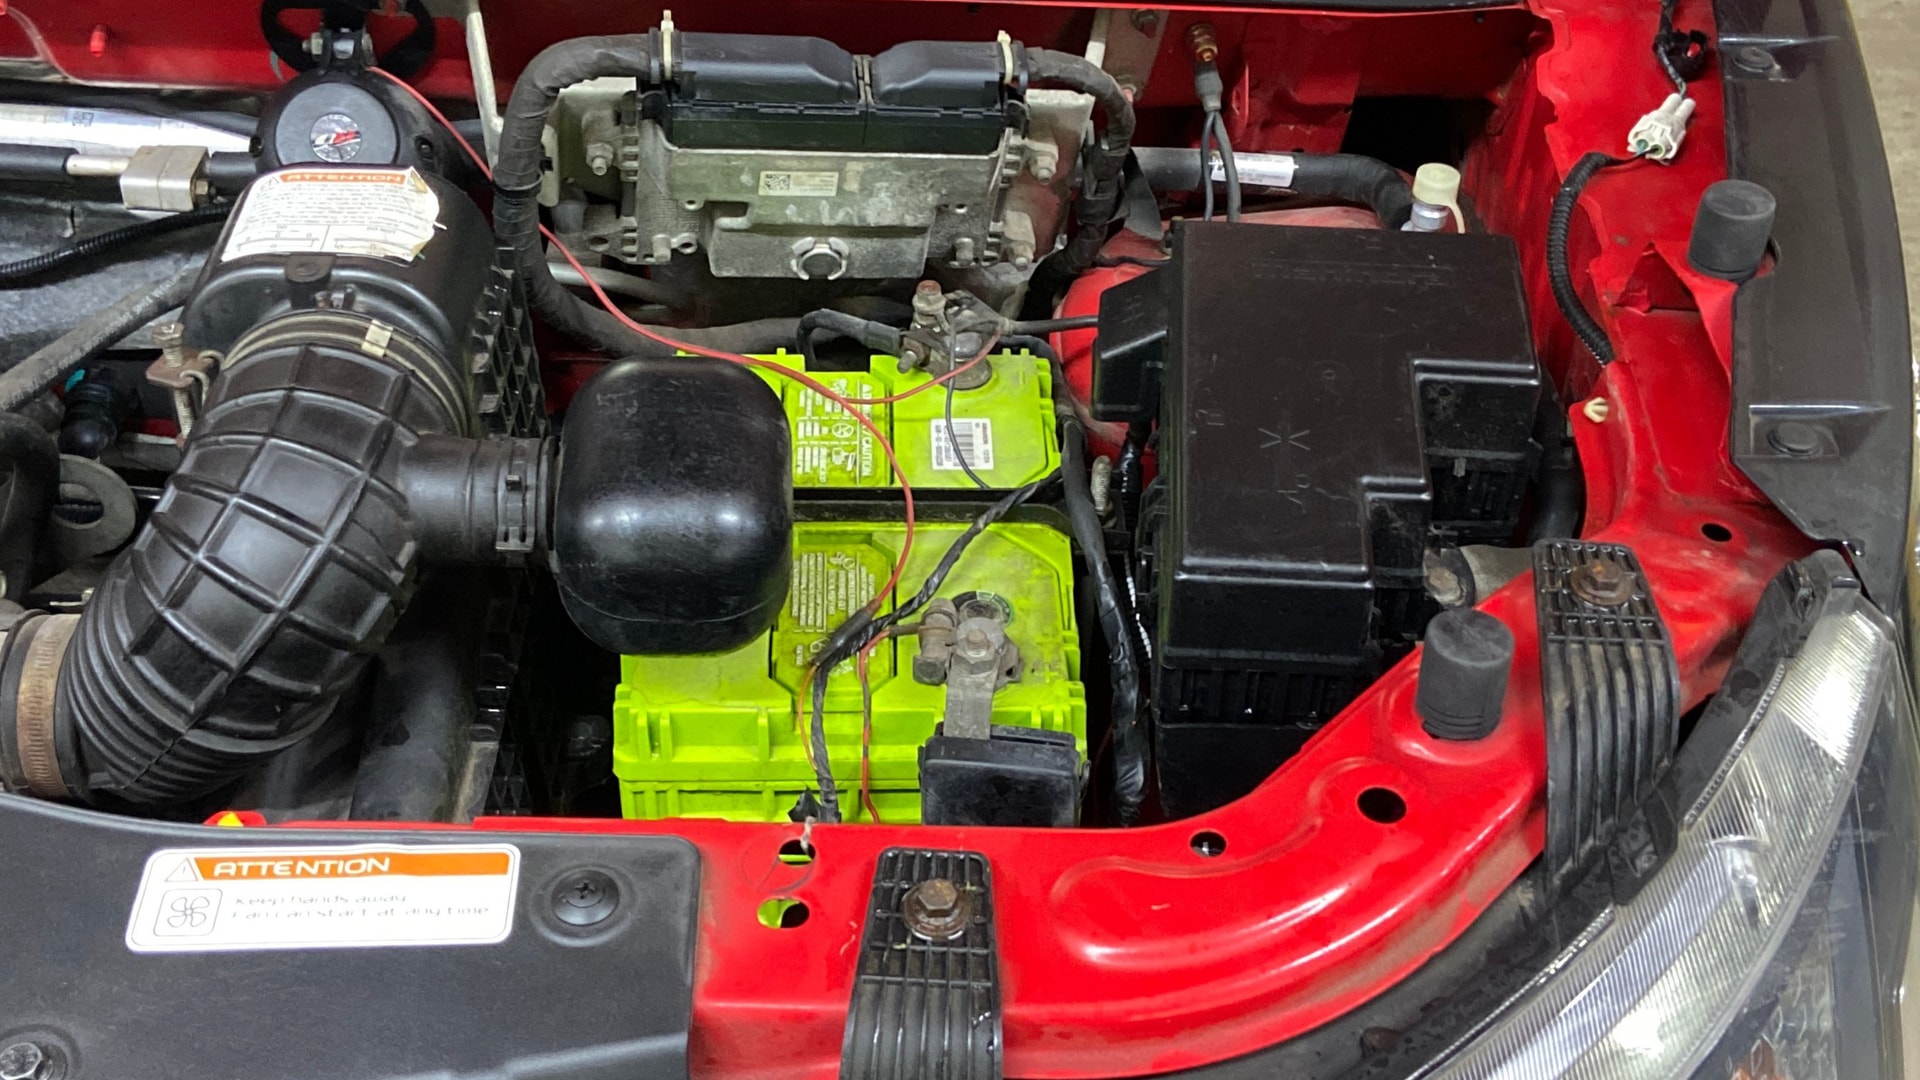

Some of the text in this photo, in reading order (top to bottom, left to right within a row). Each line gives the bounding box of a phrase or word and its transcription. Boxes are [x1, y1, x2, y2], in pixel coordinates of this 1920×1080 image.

[286, 173, 402, 183] ATTENTION
[213, 857, 390, 877] ATTENTION
[377, 907, 395, 916] at
